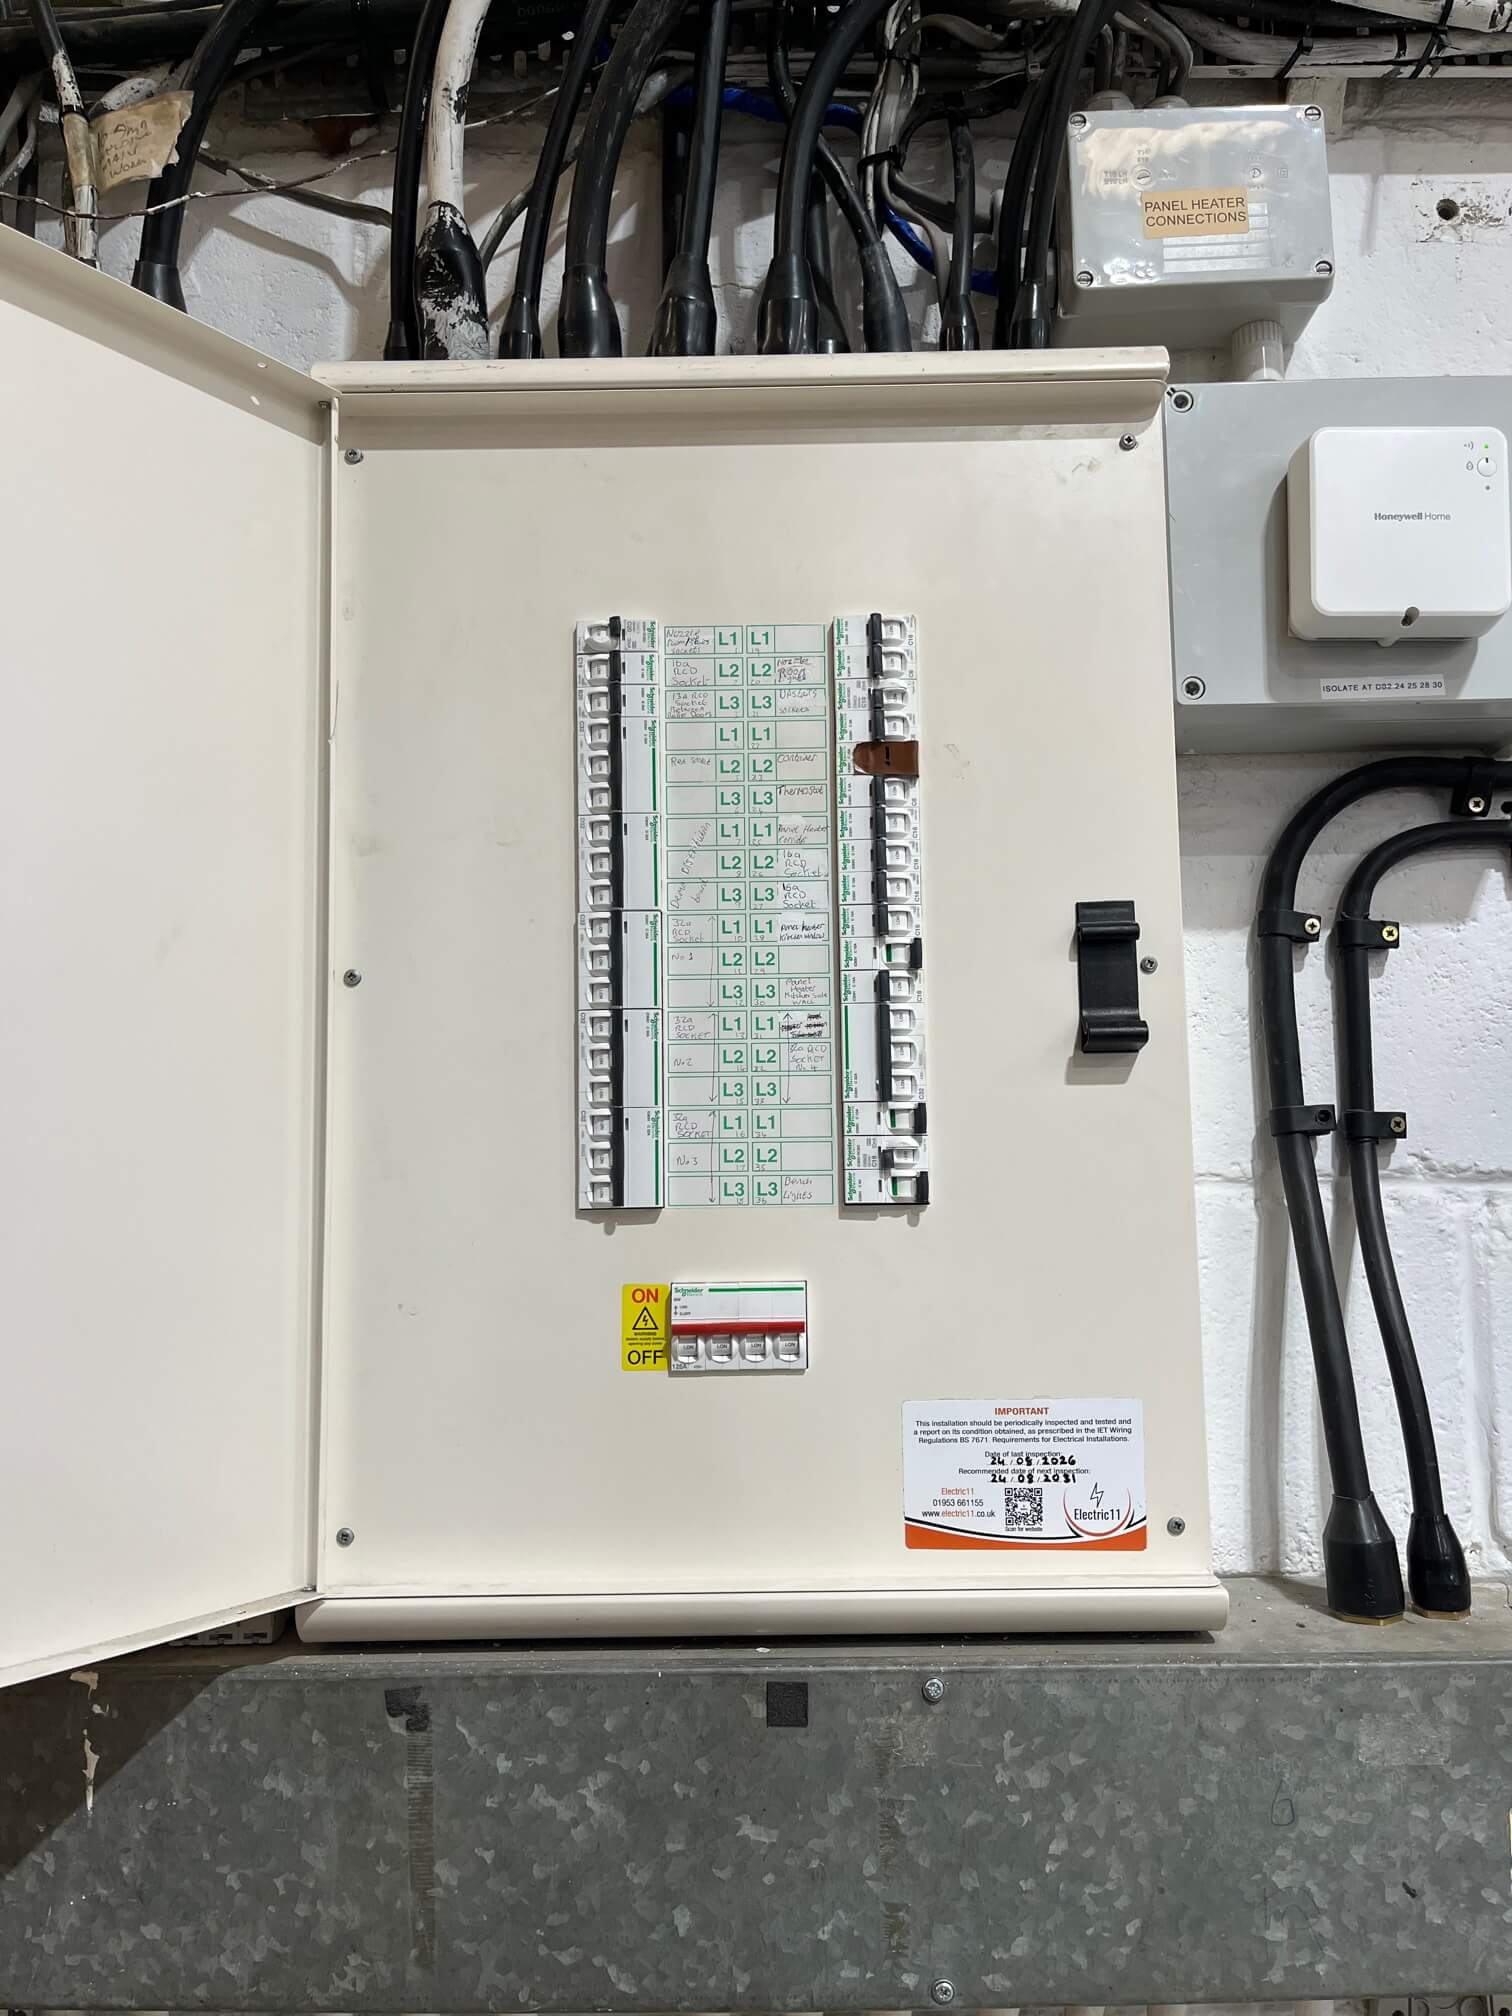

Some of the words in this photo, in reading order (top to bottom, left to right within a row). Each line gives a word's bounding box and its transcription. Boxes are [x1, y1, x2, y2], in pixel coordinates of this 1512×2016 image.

[1144, 200, 1188, 212] PANEL
[1191, 197, 1245, 210] HEATER
[1145, 211, 1247, 227] CONNECTIONS
[1374, 512, 1423, 522] Honeywell
[1424, 512, 1451, 521] Home
[719, 632, 737, 645] L1
[751, 631, 769, 645] L1
[719, 664, 740, 677] L2
[752, 663, 772, 677] L2
[1322, 684, 1359, 693] ISOLATE
[1361, 683, 1372, 691] AT
[1432, 681, 1443, 689] 30
[720, 696, 740, 709] L3
[752, 695, 773, 709] L3
[720, 728, 738, 741] L1
[752, 727, 770, 741] L1
[720, 760, 741, 773] L2
[753, 759, 773, 773] L2
[720, 792, 741, 805] L3
[753, 791, 774, 805] L3
[721, 824, 739, 837] L1
[753, 823, 771, 837] L1
[721, 856, 741, 869] L2
[754, 855, 774, 869] L2
[721, 888, 742, 901] L3
[754, 887, 775, 901] L3
[721, 920, 739, 934] L1
[754, 919, 772, 934] L1
[722, 953, 742, 966] L2
[755, 952, 775, 966] L2
[722, 985, 742, 999] L3
[755, 984, 776, 999] L3
[722, 1017, 740, 1031] L1
[756, 1017, 774, 1031] L1
[722, 1050, 743, 1064] L2
[756, 1050, 776, 1064] L2
[723, 1083, 743, 1097] L3
[756, 1083, 777, 1097] L3
[723, 1116, 741, 1129] L1
[757, 1116, 775, 1129] L1
[723, 1149, 744, 1163] L2
[757, 1149, 777, 1163] L2
[724, 1182, 744, 1196] L3
[757, 1182, 778, 1196] L3
[632, 1288, 659, 1303] ON
[674, 1288, 704, 1296] Schneider
[628, 1350, 664, 1365] OFF
[994, 1407, 1050, 1416] IMPORTANT
[932, 1419, 968, 1427] installation
[1004, 1419, 1043, 1428] periodically
[1045, 1418, 1078, 1427] inspected
[1037, 1427, 1074, 1436] prescribed
[1109, 1426, 1132, 1434] Wiring
[992, 1436, 1040, 1444] Requirements
[1027, 1467, 1035, 1475] of
[941, 1487, 974, 1496] Electric11
[932, 1498, 956, 1507] 01953
[957, 1498, 984, 1507] 661155
[921, 1509, 996, 1518] www.electric11.co.uk
[1074, 1508, 1120, 1520] Electric11
